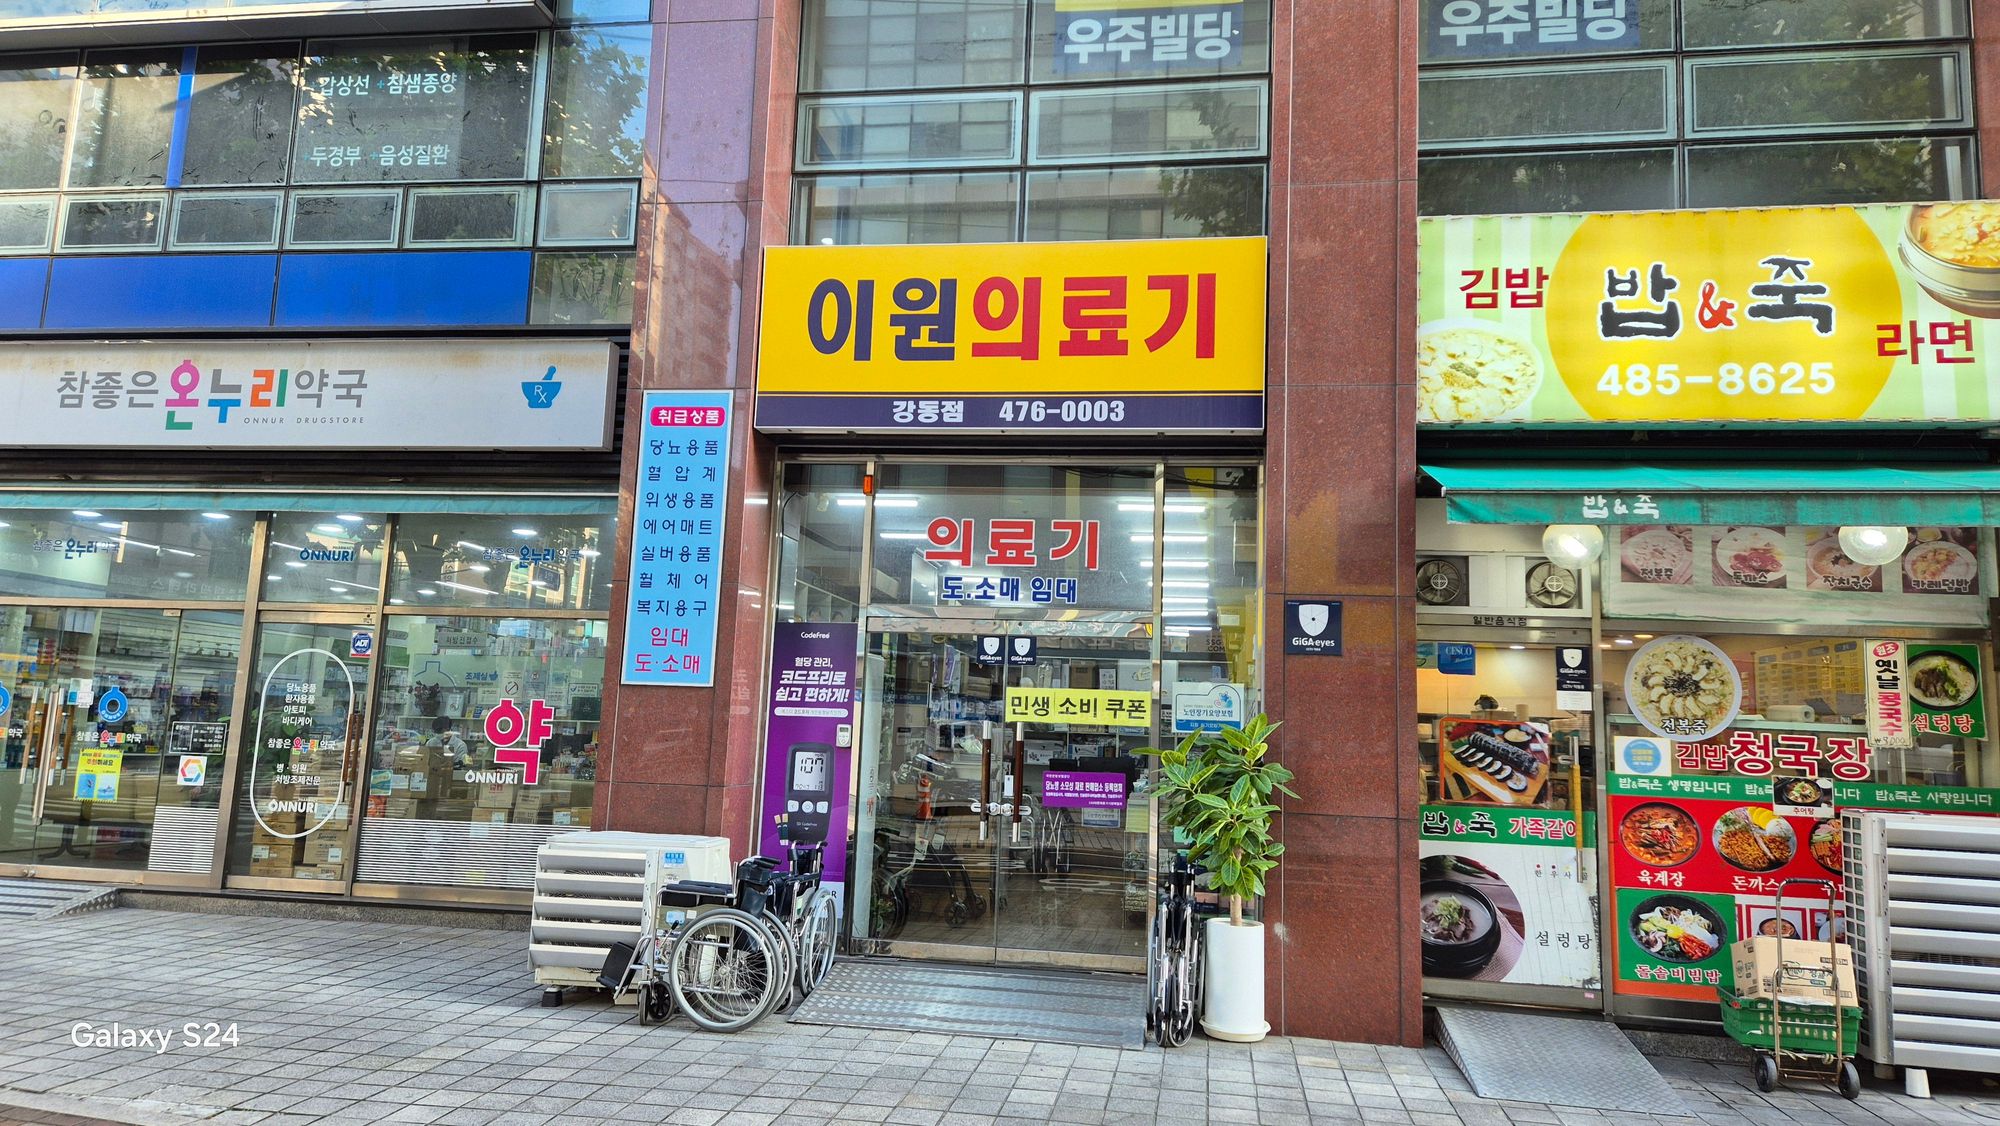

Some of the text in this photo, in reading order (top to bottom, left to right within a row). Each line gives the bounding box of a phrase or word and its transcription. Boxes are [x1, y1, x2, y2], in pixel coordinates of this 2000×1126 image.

[1439, 0, 1626, 47] 우주빌딩
[1063, 11, 1233, 65] 우주빌딩
[319, 72, 457, 96] 갑상선 침샘종양
[310, 144, 450, 167] 두경부 음성질환
[1459, 266, 1549, 309] 김밥
[807, 272, 1217, 361] 이원의료기
[1876, 319, 1975, 364] 라면
[1597, 361, 1836, 396] 485-8625
[657, 409, 720, 425] 취급상품
[892, 399, 1125, 422] 강동점 476-0003
[650, 439, 718, 456] 당뇨용품
[645, 492, 714, 509] 위생용품
[643, 518, 712, 535] 에어매트
[641, 545, 711, 562] 실버용품
[924, 516, 1100, 571] 의료기
[1030, 576, 1078, 603] 임대
[637, 599, 707, 617] 복지용구
[355, 639, 369, 647] ADT
[651, 627, 689, 647] 임대
[780, 670, 847, 685] 코드프리로
[775, 687, 850, 702] 쉽고 편하게!
[1011, 696, 1050, 716] 민생
[1058, 697, 1097, 718] 소비
[1106, 699, 1147, 719] 쿠폰
[1661, 717, 1708, 735] 전복죽
[1912, 713, 1974, 734] 설렁탕
[484, 698, 555, 785] 약
[801, 757, 824, 774] 107
[1675, 743, 1729, 770] 김밥
[1730, 730, 1873, 782] 청국장
[465, 769, 518, 784] ONNURI
[1927, 792, 1993, 806] 사랑입니다
[1732, 875, 1780, 893] 돈까스
